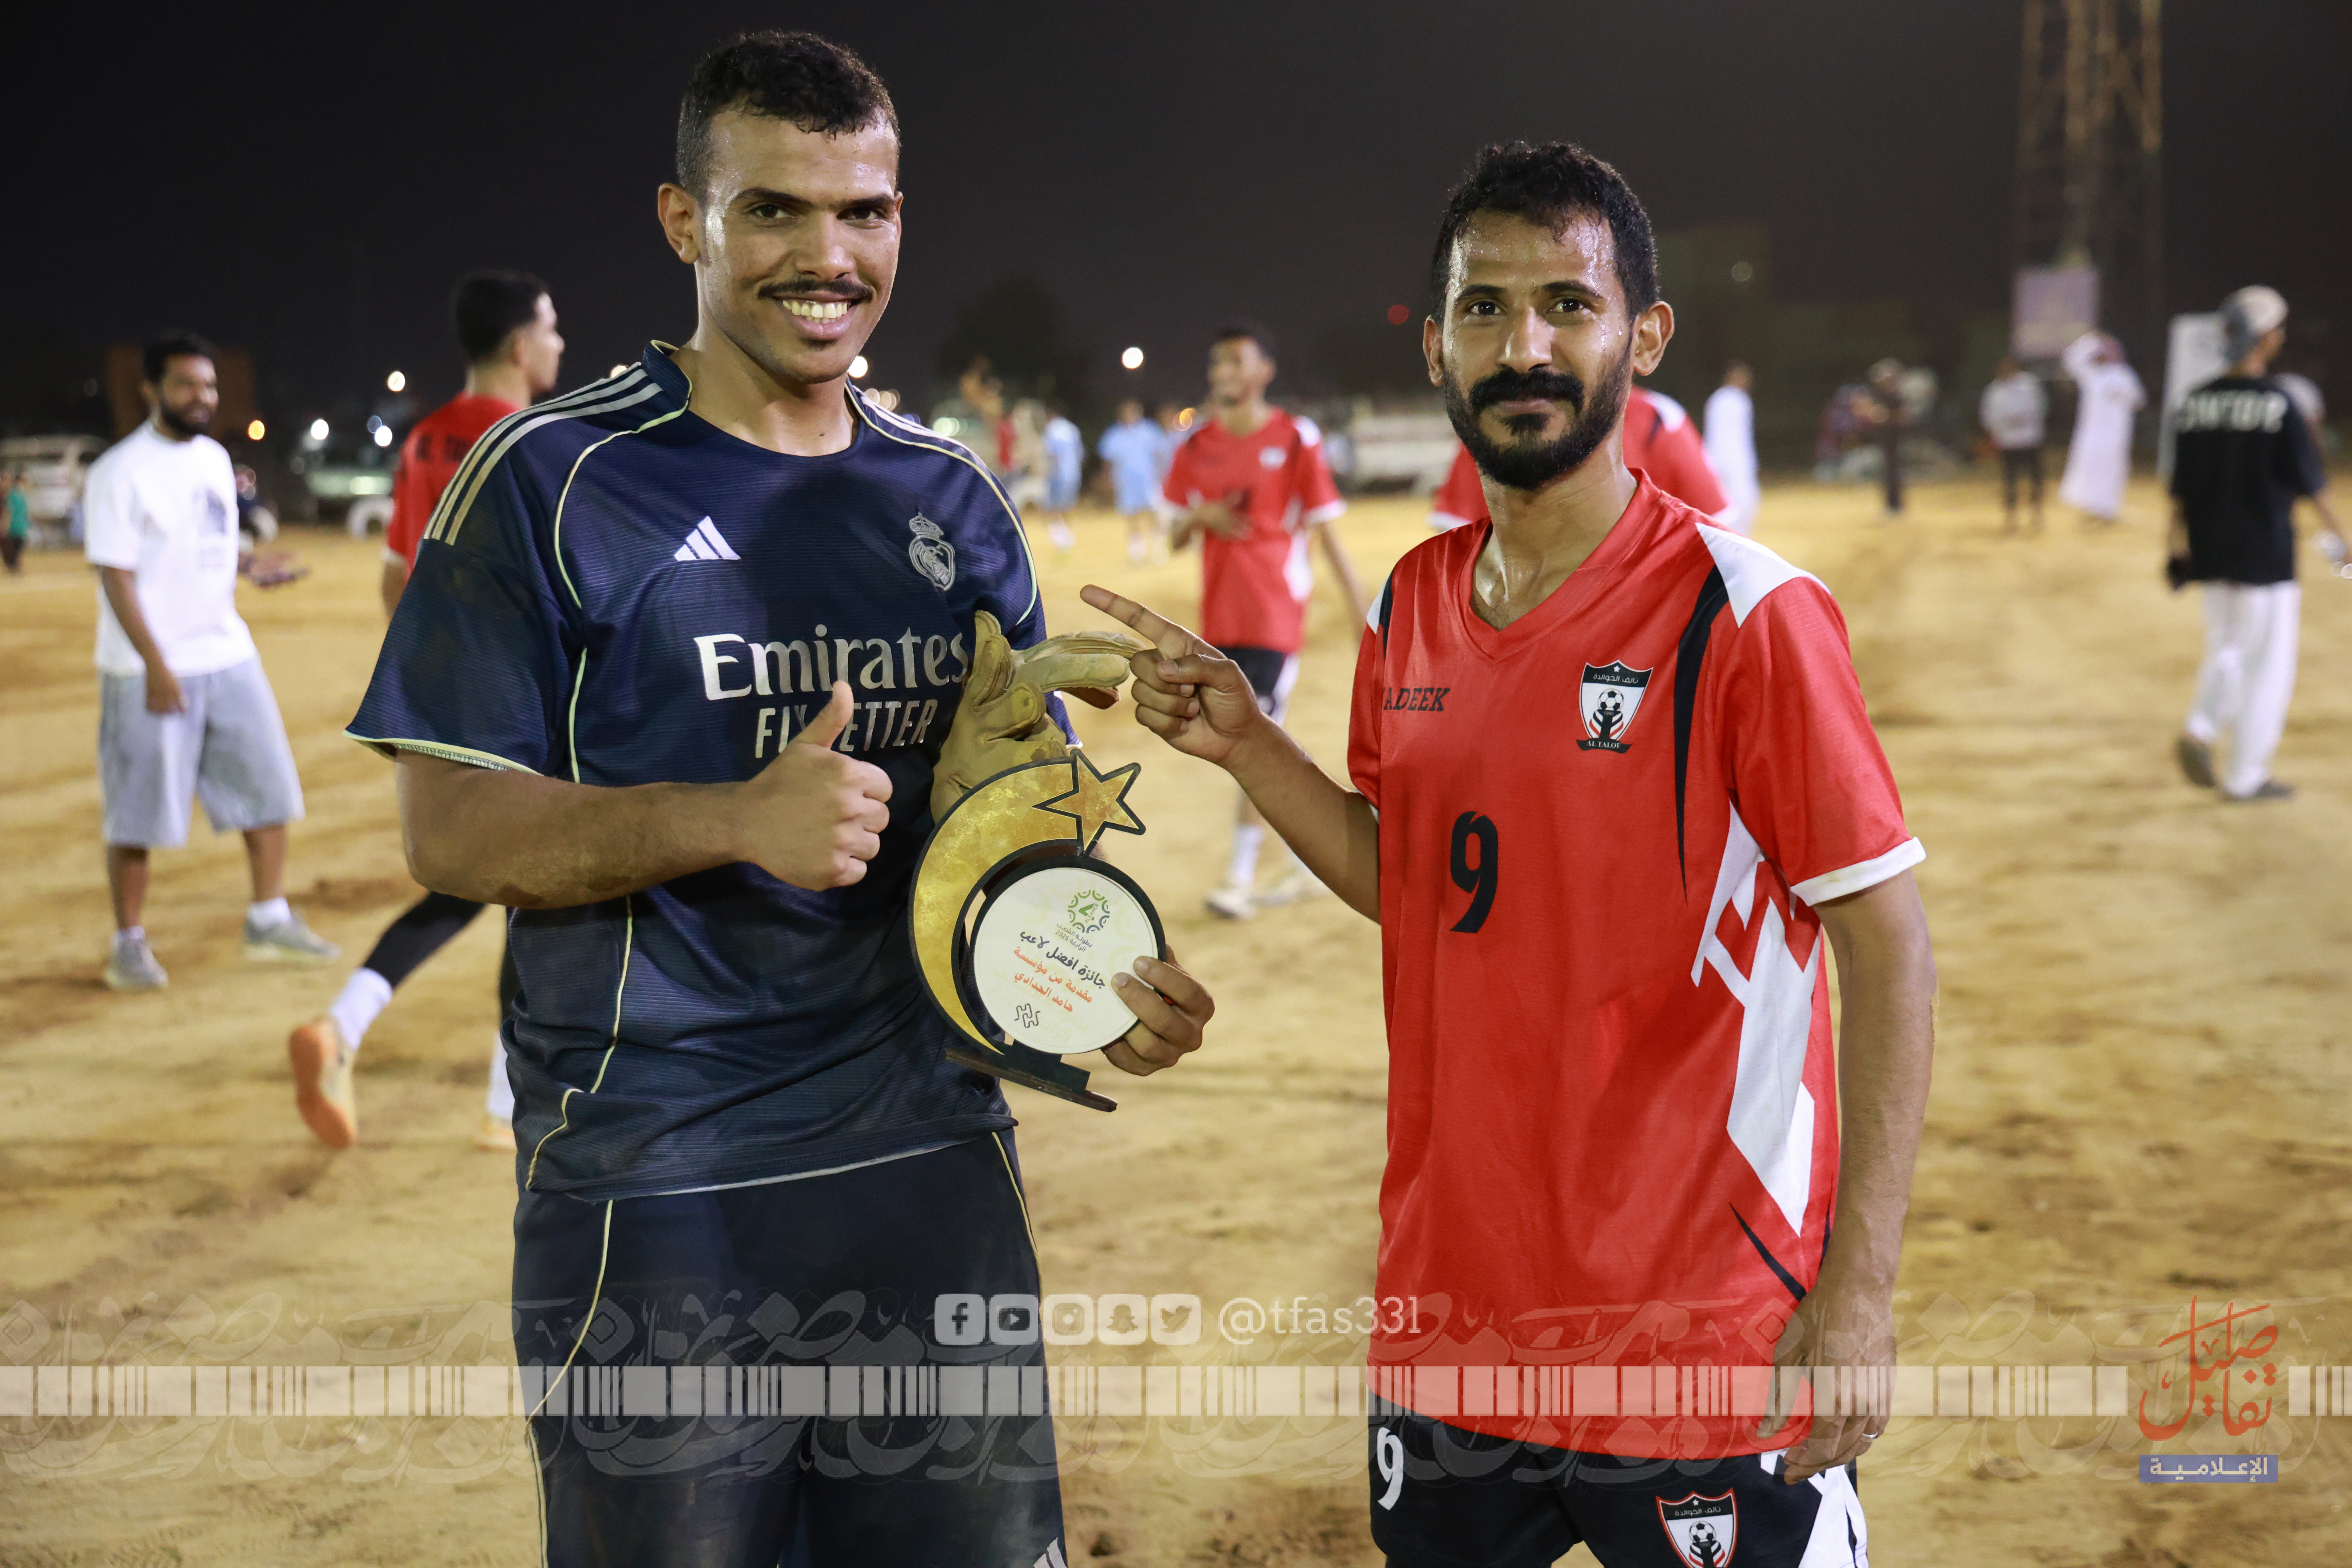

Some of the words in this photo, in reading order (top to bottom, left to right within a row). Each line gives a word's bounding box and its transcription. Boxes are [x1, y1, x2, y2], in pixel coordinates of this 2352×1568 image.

[693, 624, 969, 701] Emirates
[1383, 688, 1450, 711] ADEEK
[838, 699, 938, 752] ETTER
[1450, 811, 1499, 933] 9
[1020, 931, 1050, 949] لاعب
[1055, 930, 1069, 942] 2026
[1057, 923, 1075, 936] الشعب
[1075, 934, 1093, 948] بطولة
[1069, 938, 1087, 952] الرابعة
[1014, 946, 1047, 975] مؤسسة
[1046, 947, 1079, 970] افضل
[1049, 973, 1063, 984] من
[1078, 965, 1105, 989] جائزة
[1066, 979, 1092, 1003] مقدمة
[1052, 996, 1073, 1012] حامد
[1376, 1427, 1404, 1510] 9
